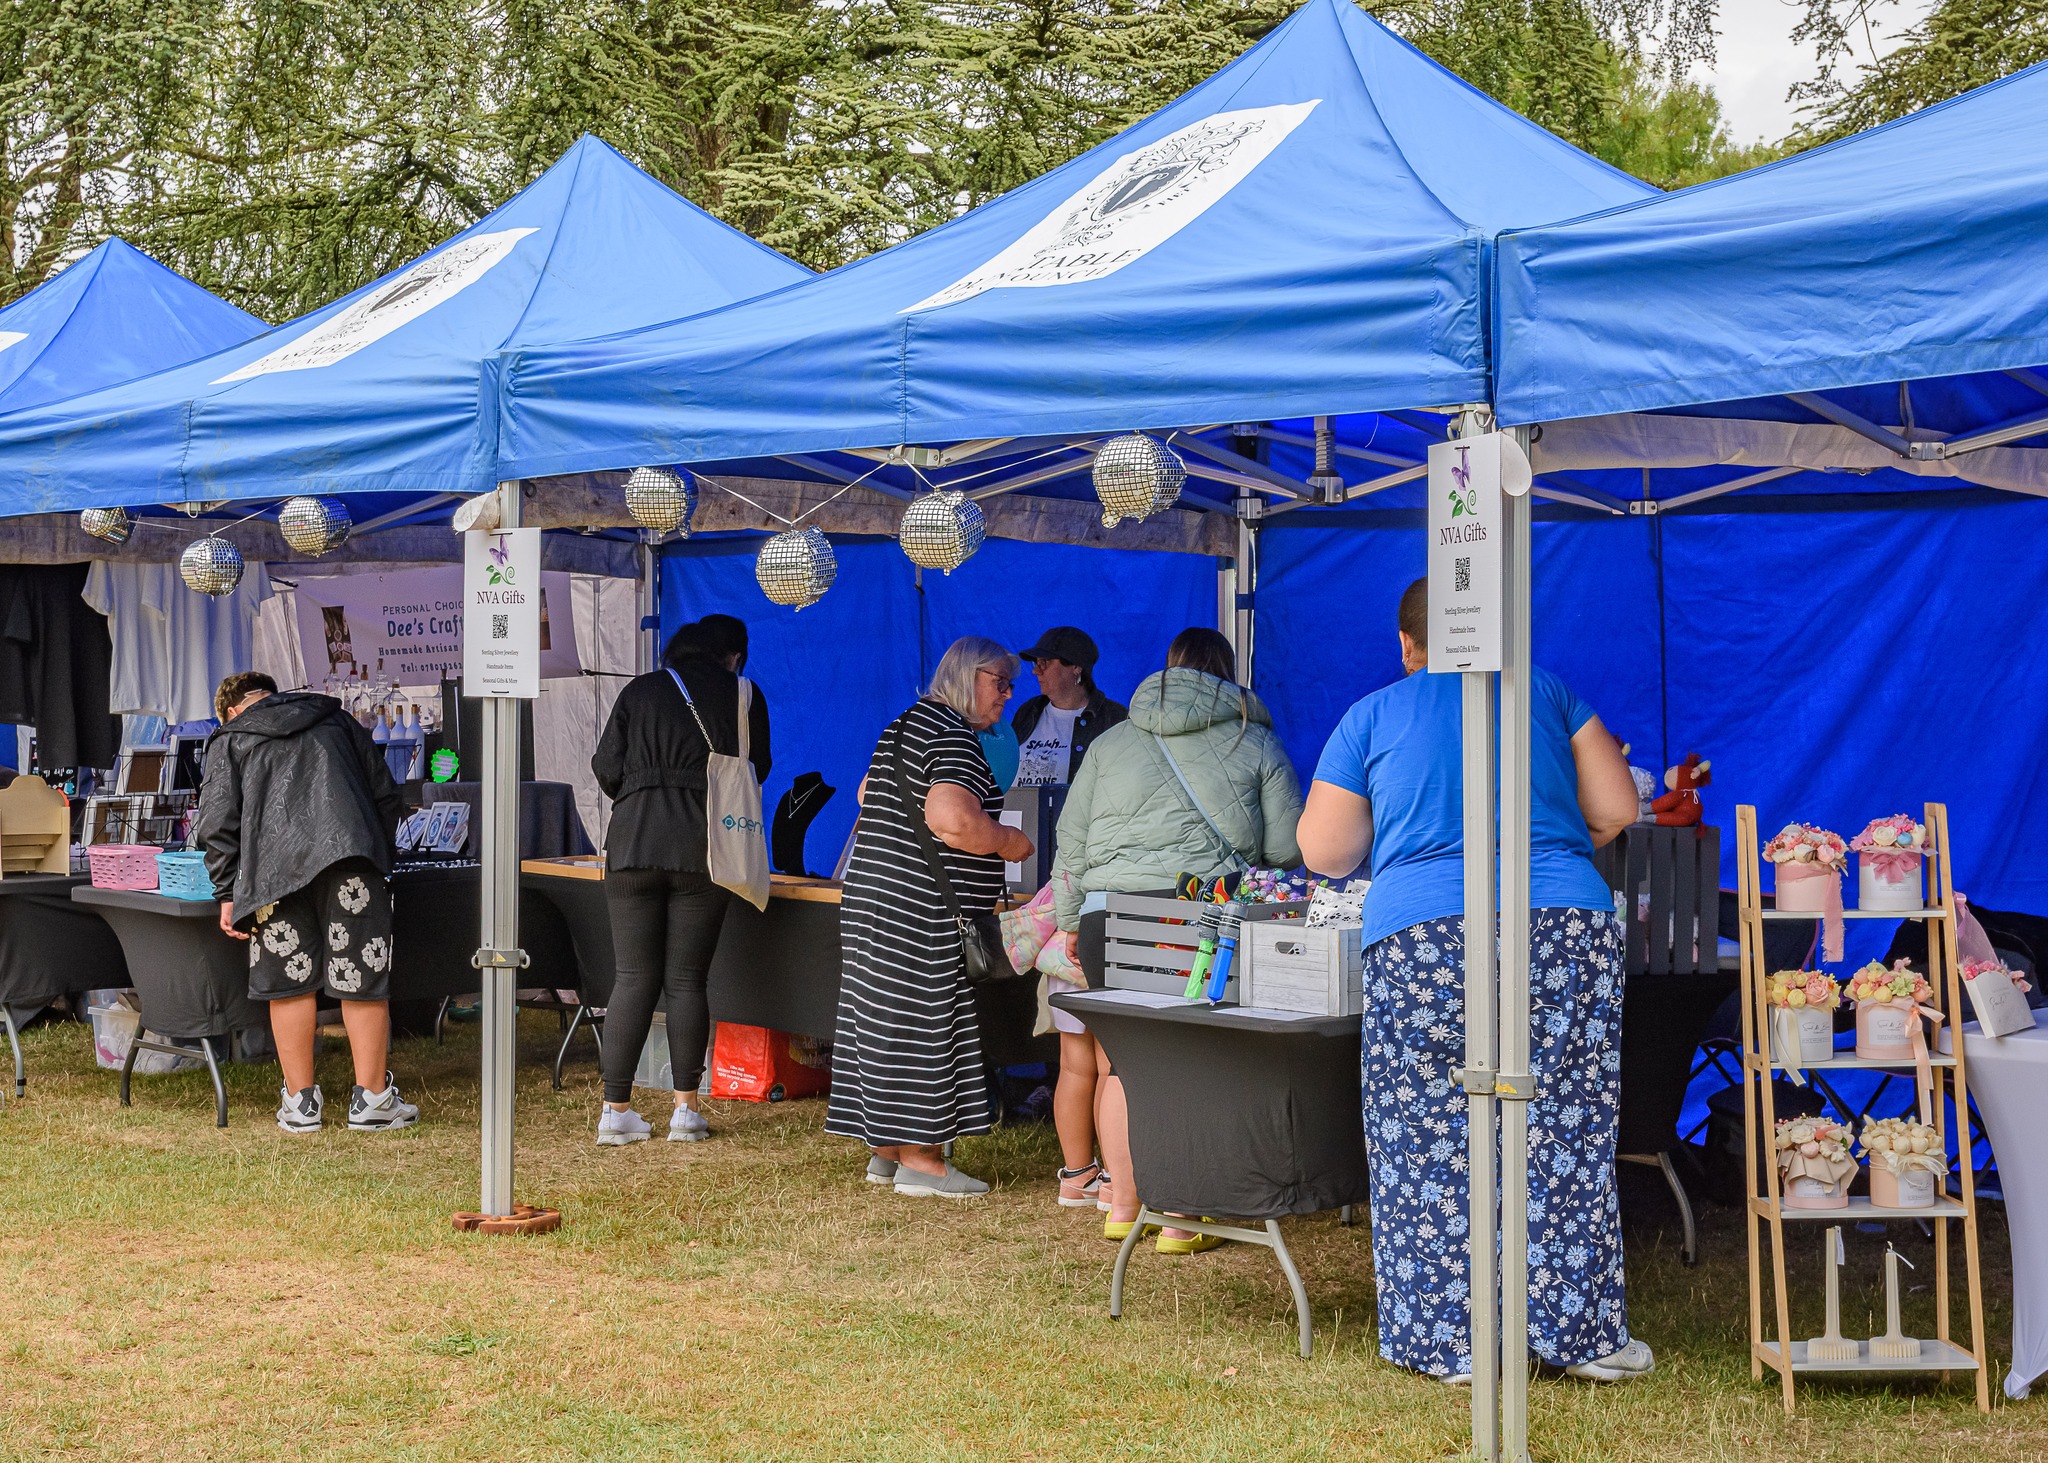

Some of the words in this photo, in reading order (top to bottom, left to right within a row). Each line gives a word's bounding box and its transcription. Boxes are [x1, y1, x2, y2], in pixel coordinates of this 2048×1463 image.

[1440, 526, 1462, 546] NVA
[1463, 522, 1487, 543] Gifts
[476, 591, 499, 605] NVA
[501, 590, 525, 605] Gifts
[382, 603, 431, 616] PERSONAL
[387, 617, 424, 638] Dee's
[378, 644, 423, 656] Homemade
[425, 642, 459, 654] Artisan
[400, 662, 418, 673] Tel:
